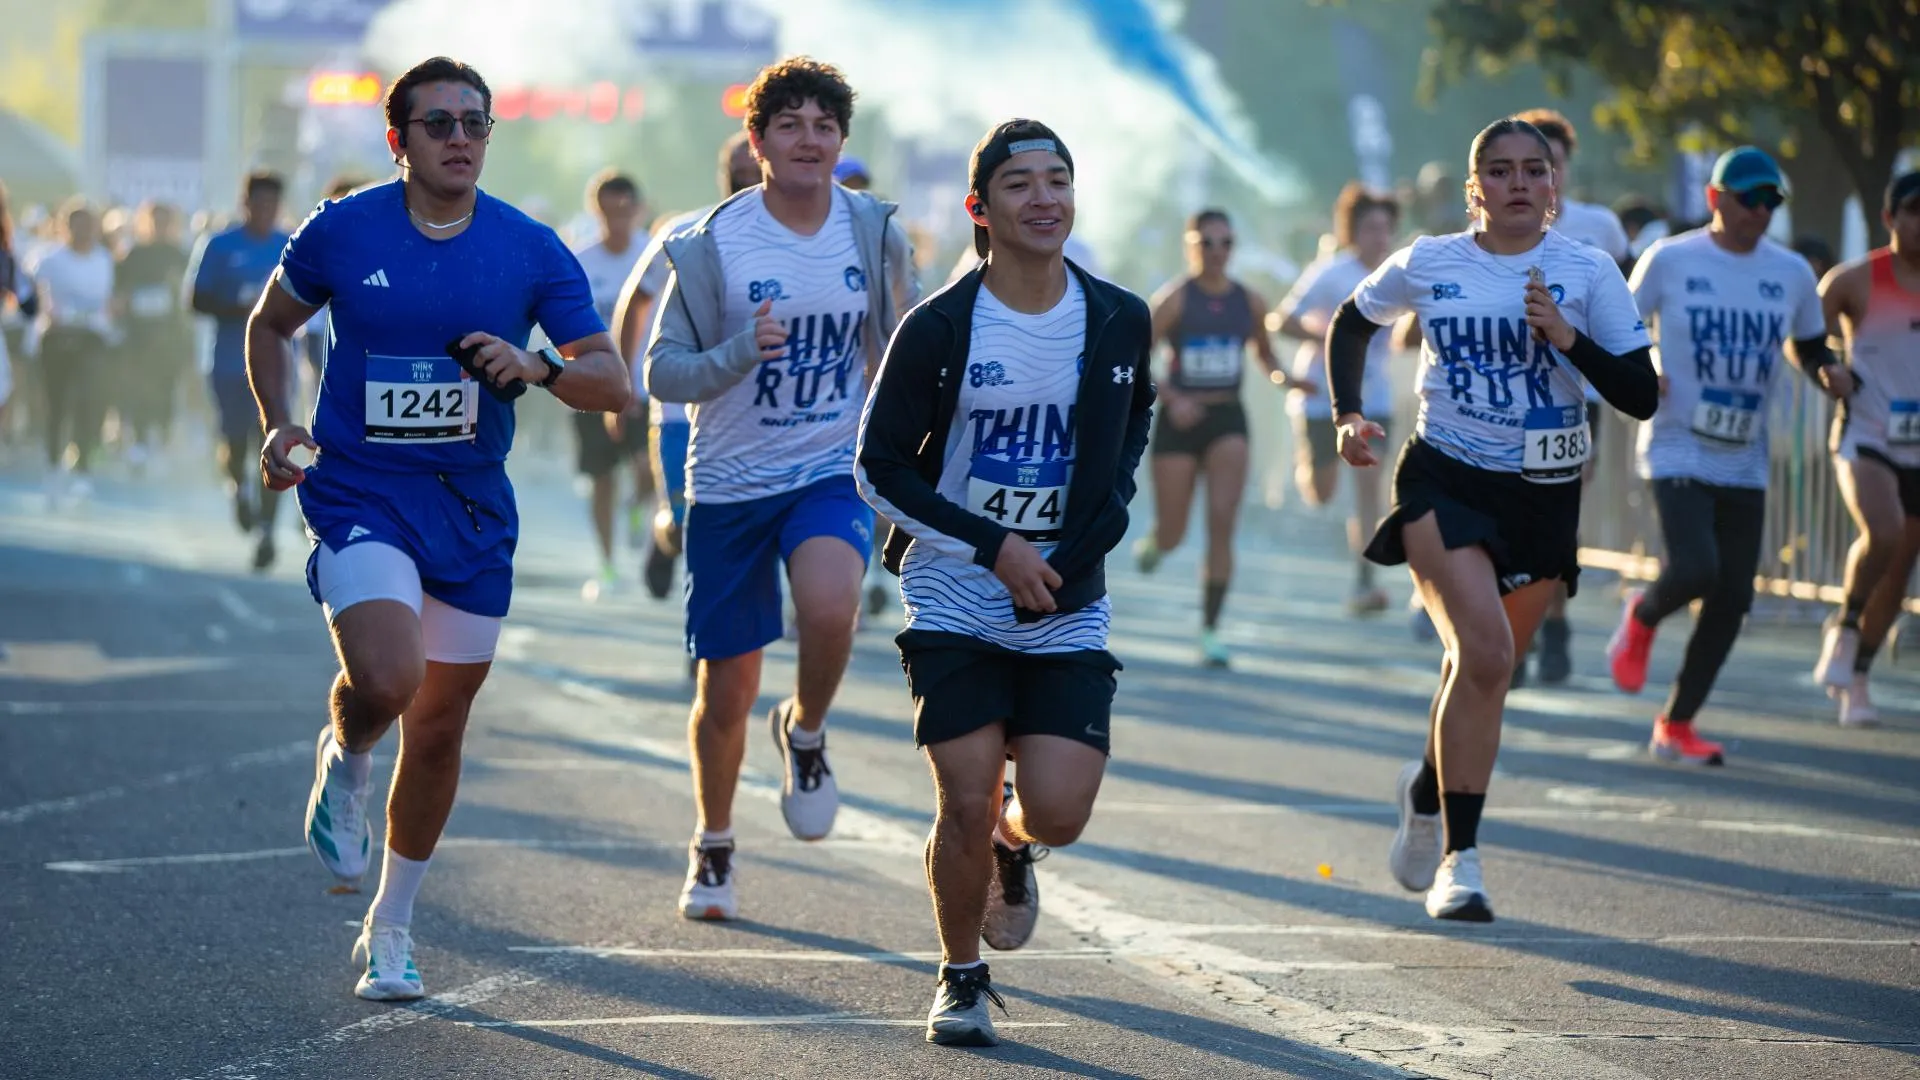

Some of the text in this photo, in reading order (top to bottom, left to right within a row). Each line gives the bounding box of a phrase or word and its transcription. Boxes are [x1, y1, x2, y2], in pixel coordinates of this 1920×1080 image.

[1684, 306, 1783, 346] THINK
[1694, 349, 1773, 384] RUN
[380, 388, 464, 419] 1242
[1448, 366, 1554, 409] RUN
[969, 403, 1077, 460] THIN
[1537, 430, 1587, 461] 1383
[983, 487, 1061, 525] 474
